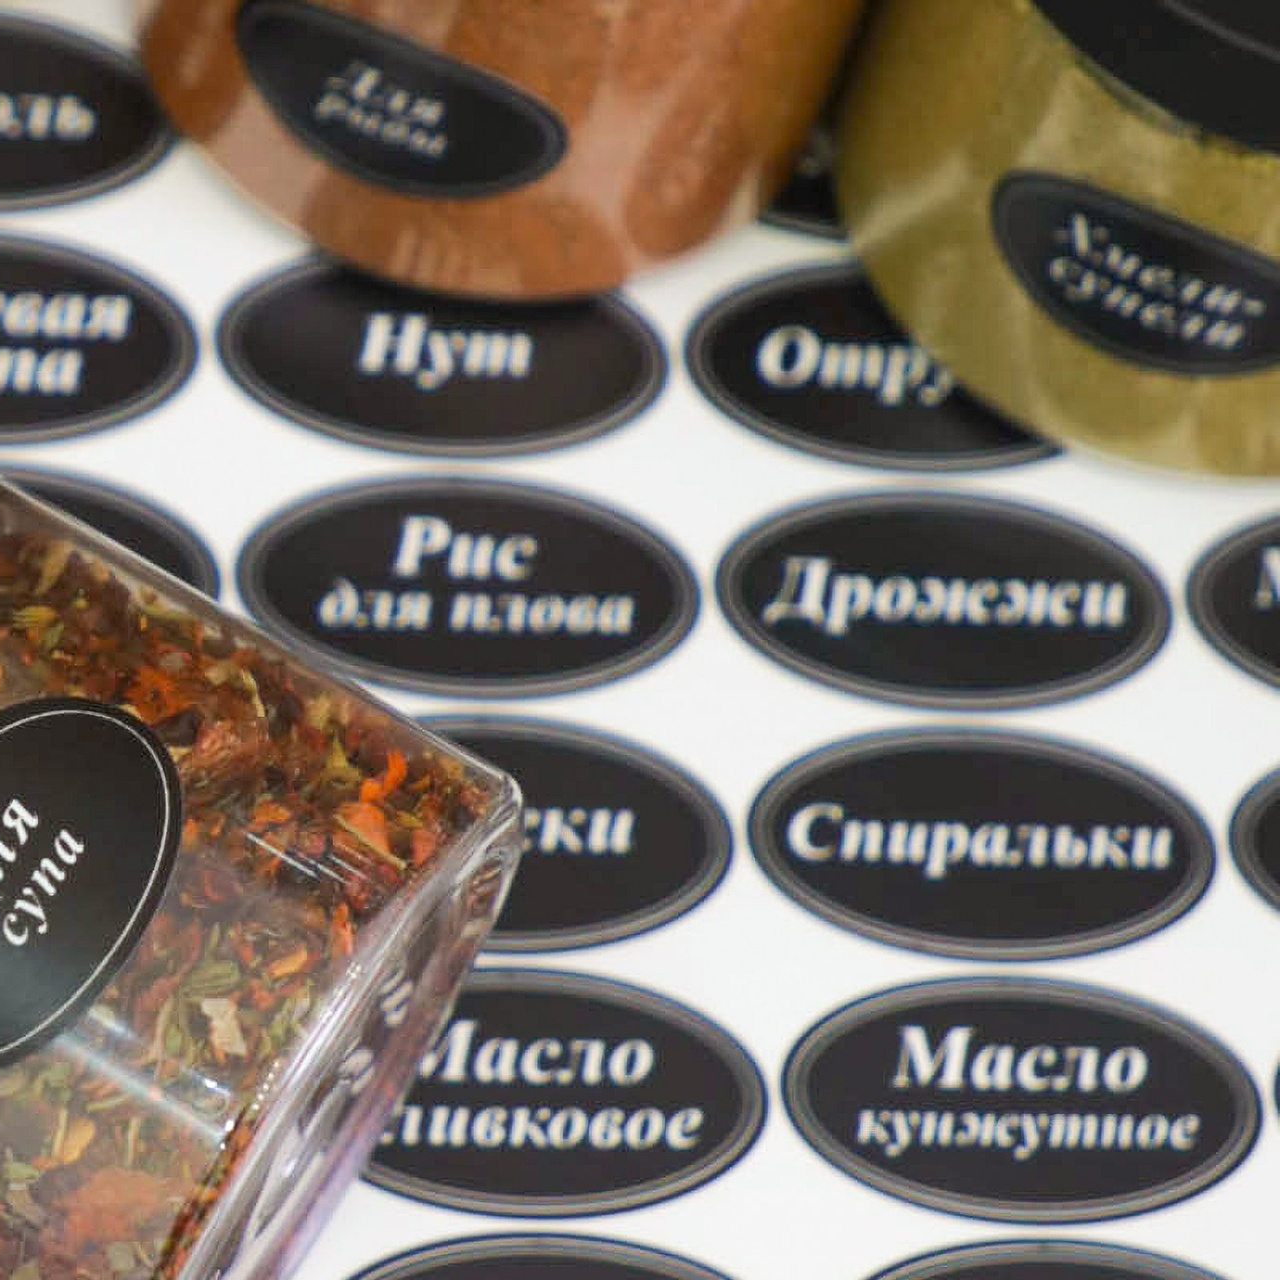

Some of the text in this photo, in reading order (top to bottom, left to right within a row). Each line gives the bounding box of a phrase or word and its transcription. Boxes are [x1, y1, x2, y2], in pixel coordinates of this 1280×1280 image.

[359, 313, 532, 390] Нут
[394, 516, 537, 580] Рис
[318, 578, 635, 635] для плова
[764, 558, 1129, 636] Дрожжи
[786, 803, 1172, 879] Спиральки
[1, 825, 86, 947] супа
[892, 1025, 1148, 1092] Масло
[382, 1104, 704, 1150] ливковое
[857, 1108, 1200, 1159] кунжутное
